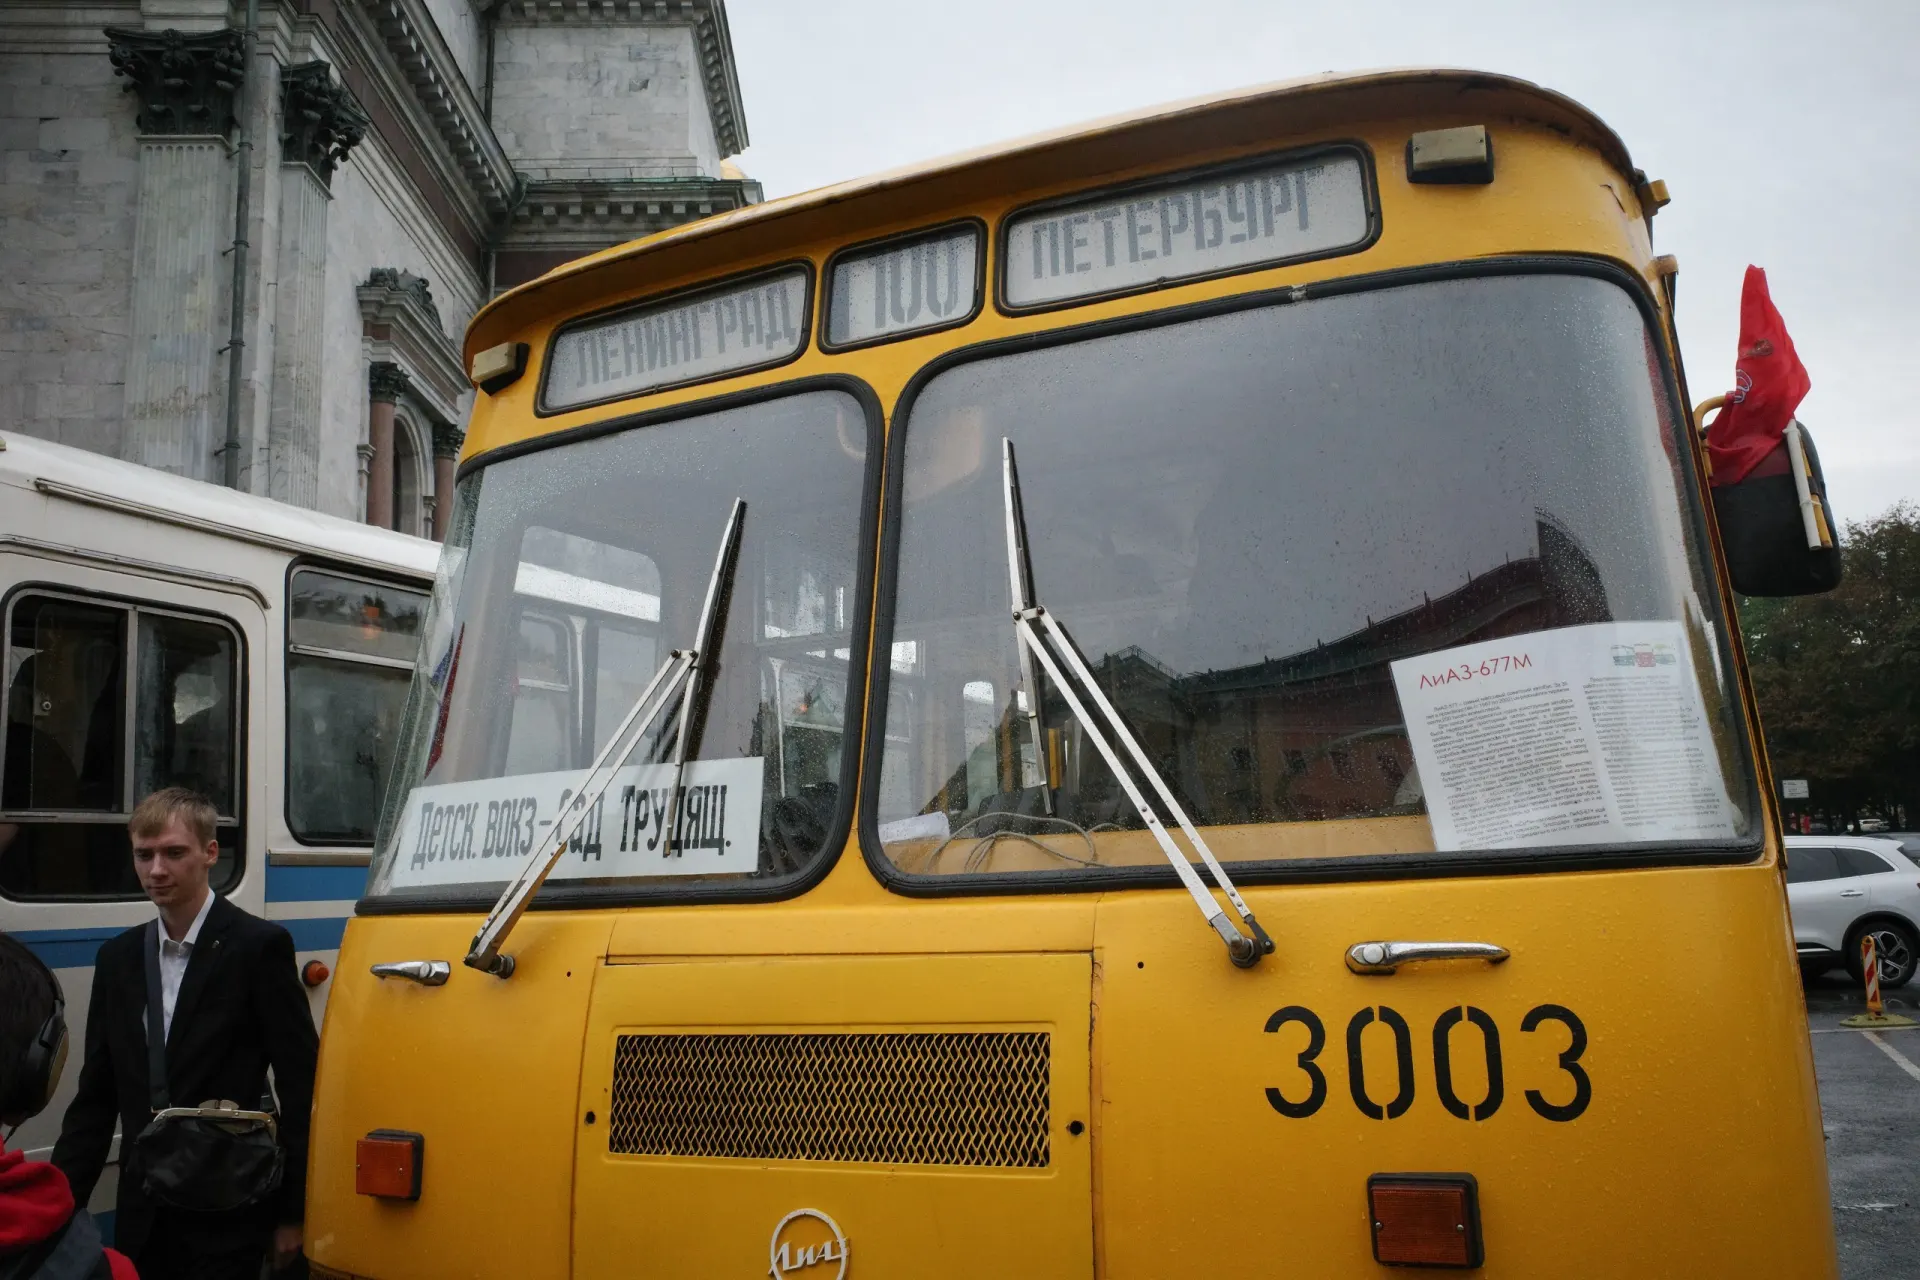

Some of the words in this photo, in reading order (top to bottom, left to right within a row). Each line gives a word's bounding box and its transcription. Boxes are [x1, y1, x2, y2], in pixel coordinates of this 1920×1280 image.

[576, 282, 797, 388] ЛЕНИНГРАД
[1031, 165, 1325, 279] ПЕТЕРБУРГ
[1419, 654, 1532, 689] ЛиАЗ-677М
[1263, 1003, 1592, 1122] 3003
